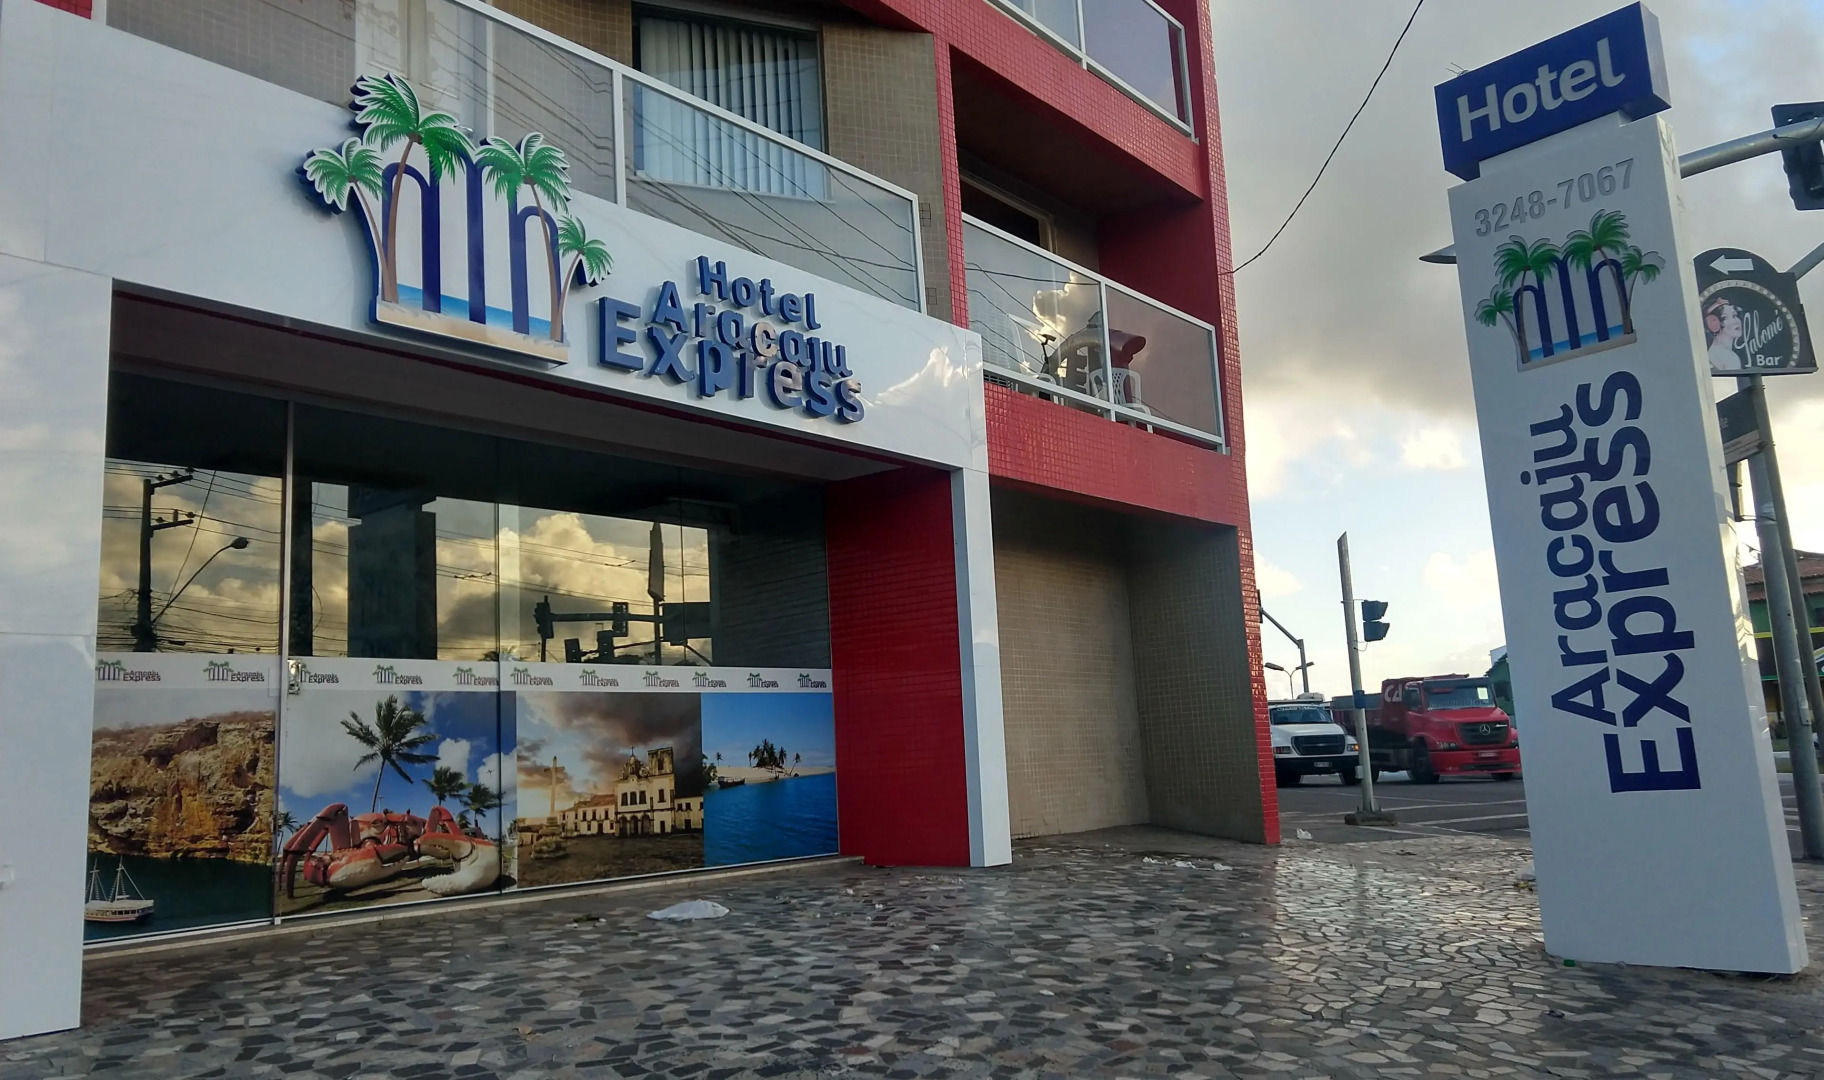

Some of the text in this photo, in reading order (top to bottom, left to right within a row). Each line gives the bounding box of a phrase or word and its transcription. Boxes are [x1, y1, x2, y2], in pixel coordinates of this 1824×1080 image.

[1457, 37, 1626, 142] Hotel
[1475, 158, 1634, 237] 3248-7067
[648, 280, 853, 378] Aracaju
[695, 255, 821, 331] Hotel
[598, 296, 865, 424] Express
[1756, 354, 1781, 366] Bar
[1520, 402, 1617, 727] Aracaju
[1576, 370, 1702, 793] Express
[123, 673, 161, 682] Express
[230, 673, 265, 682] Express
[308, 675, 339, 684] Express
[395, 676, 423, 685] Express
